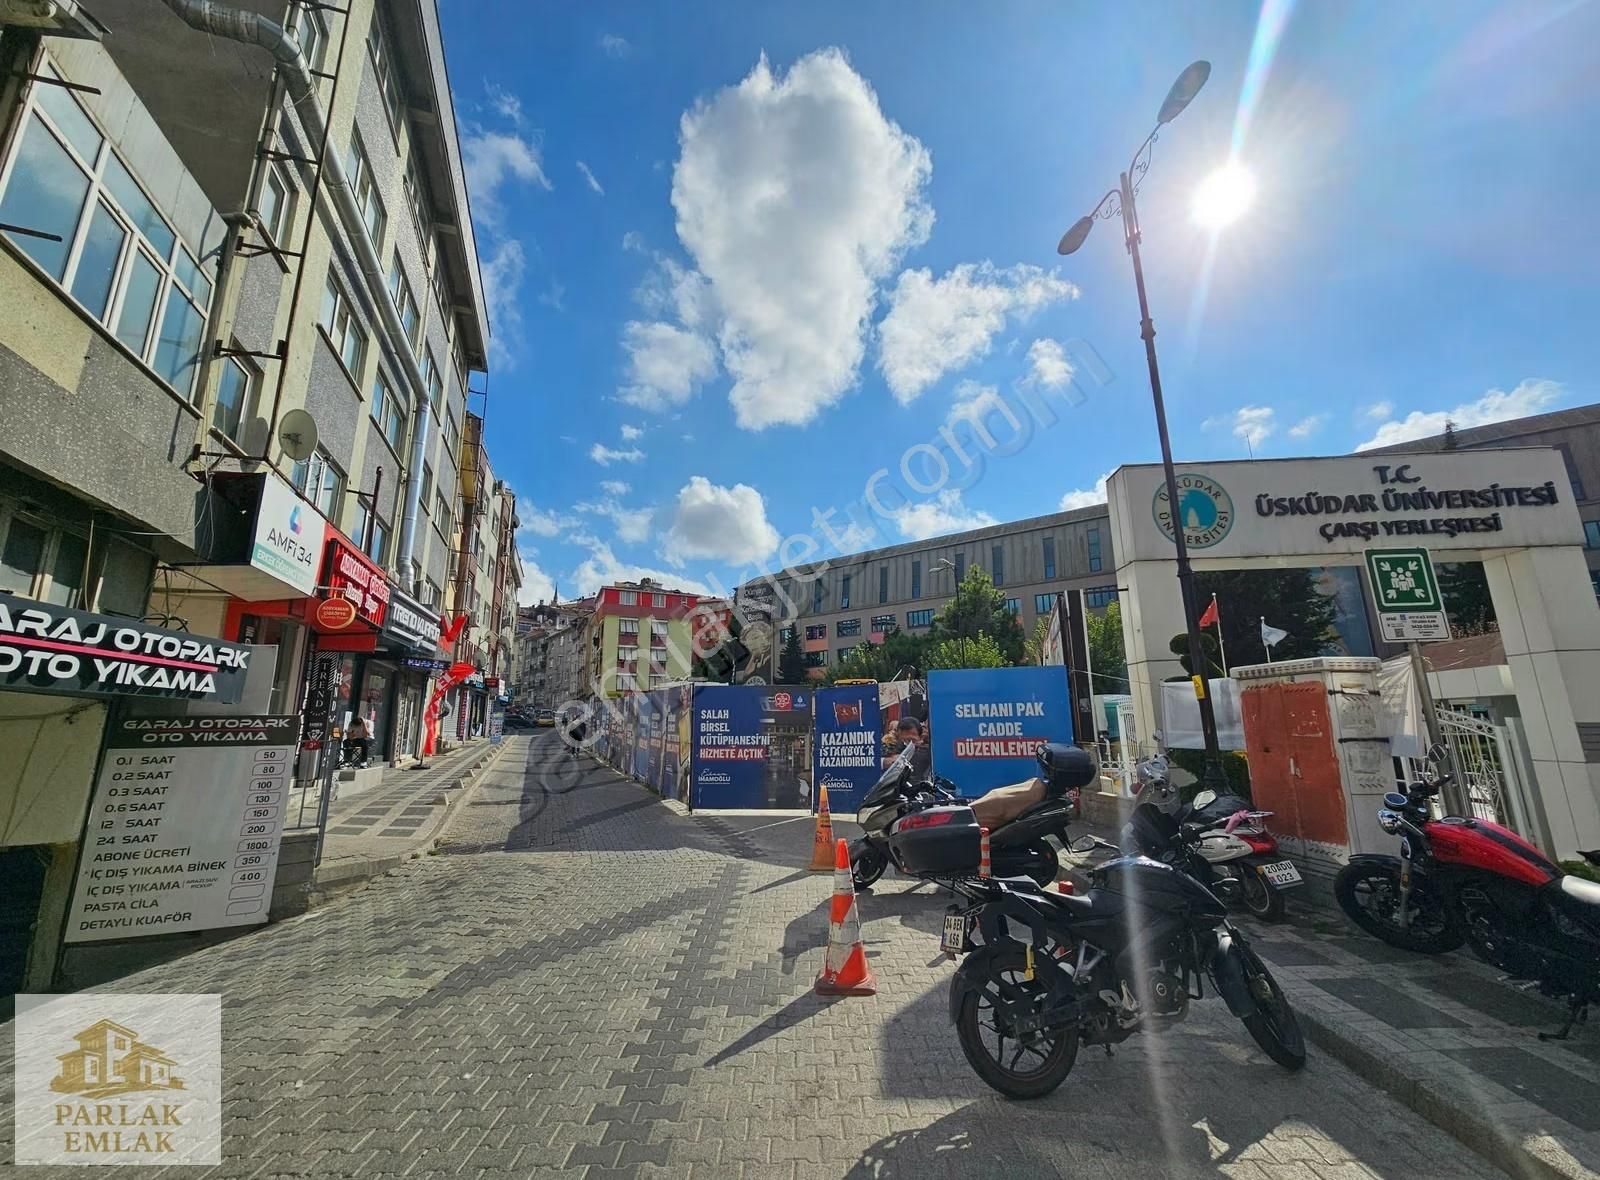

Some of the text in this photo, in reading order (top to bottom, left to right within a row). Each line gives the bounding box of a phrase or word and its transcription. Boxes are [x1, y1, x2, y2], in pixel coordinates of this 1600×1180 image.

[1158, 477, 1222, 502] ÜKÜDAR
[1255, 481, 1559, 517] ÜSKÜDAR ÜNİVERSİTESİ
[1319, 512, 1503, 543] ÇARŞI YERLEŞKESİ
[113, 628, 250, 669] OTOPARK
[0, 646, 216, 693] OTO YIKAMA
[700, 709, 729, 719] SALAH
[955, 702, 1045, 718] SELMANI PAK
[123, 718, 290, 730] GARAJ OTOPARK
[700, 720, 730, 732] BİRSEL
[978, 721, 1023, 737] CADDE
[142, 731, 268, 742] OTO YIKAMA
[700, 733, 770, 746] KÜTÜPHANESİ'Nİ
[821, 731, 876, 746] KAZANDIK
[700, 747, 764, 760] HİZMETE AÇTIK
[819, 745, 875, 757] İSTANBUL'A
[956, 739, 1047, 757] DÜZENLEME
[116, 751, 276, 766] 0.1 SAAT 50
[819, 756, 875, 767] KAZANDIRDIK
[112, 766, 275, 781] 0.2 SAAT 80
[108, 781, 272, 797] 0.3 SAAT 100
[105, 795, 270, 813] 0.6 SAAT 130
[101, 820, 114, 829] 12
[126, 818, 162, 828] SAAT
[97, 825, 265, 845] 24 SAAT 200
[93, 841, 268, 862] ABONE ÜCRETİ 1800
[90, 857, 261, 880] İÇ DIŞ YIKAMA BİNEK 350
[87, 885, 99, 898] İÇ
[129, 881, 180, 893] YIKAMA
[239, 872, 261, 881] 400
[1276, 872, 1295, 883] 023
[83, 899, 159, 913] PASTA CİLA
[80, 912, 192, 931] DETAYLI KUAFÖR
